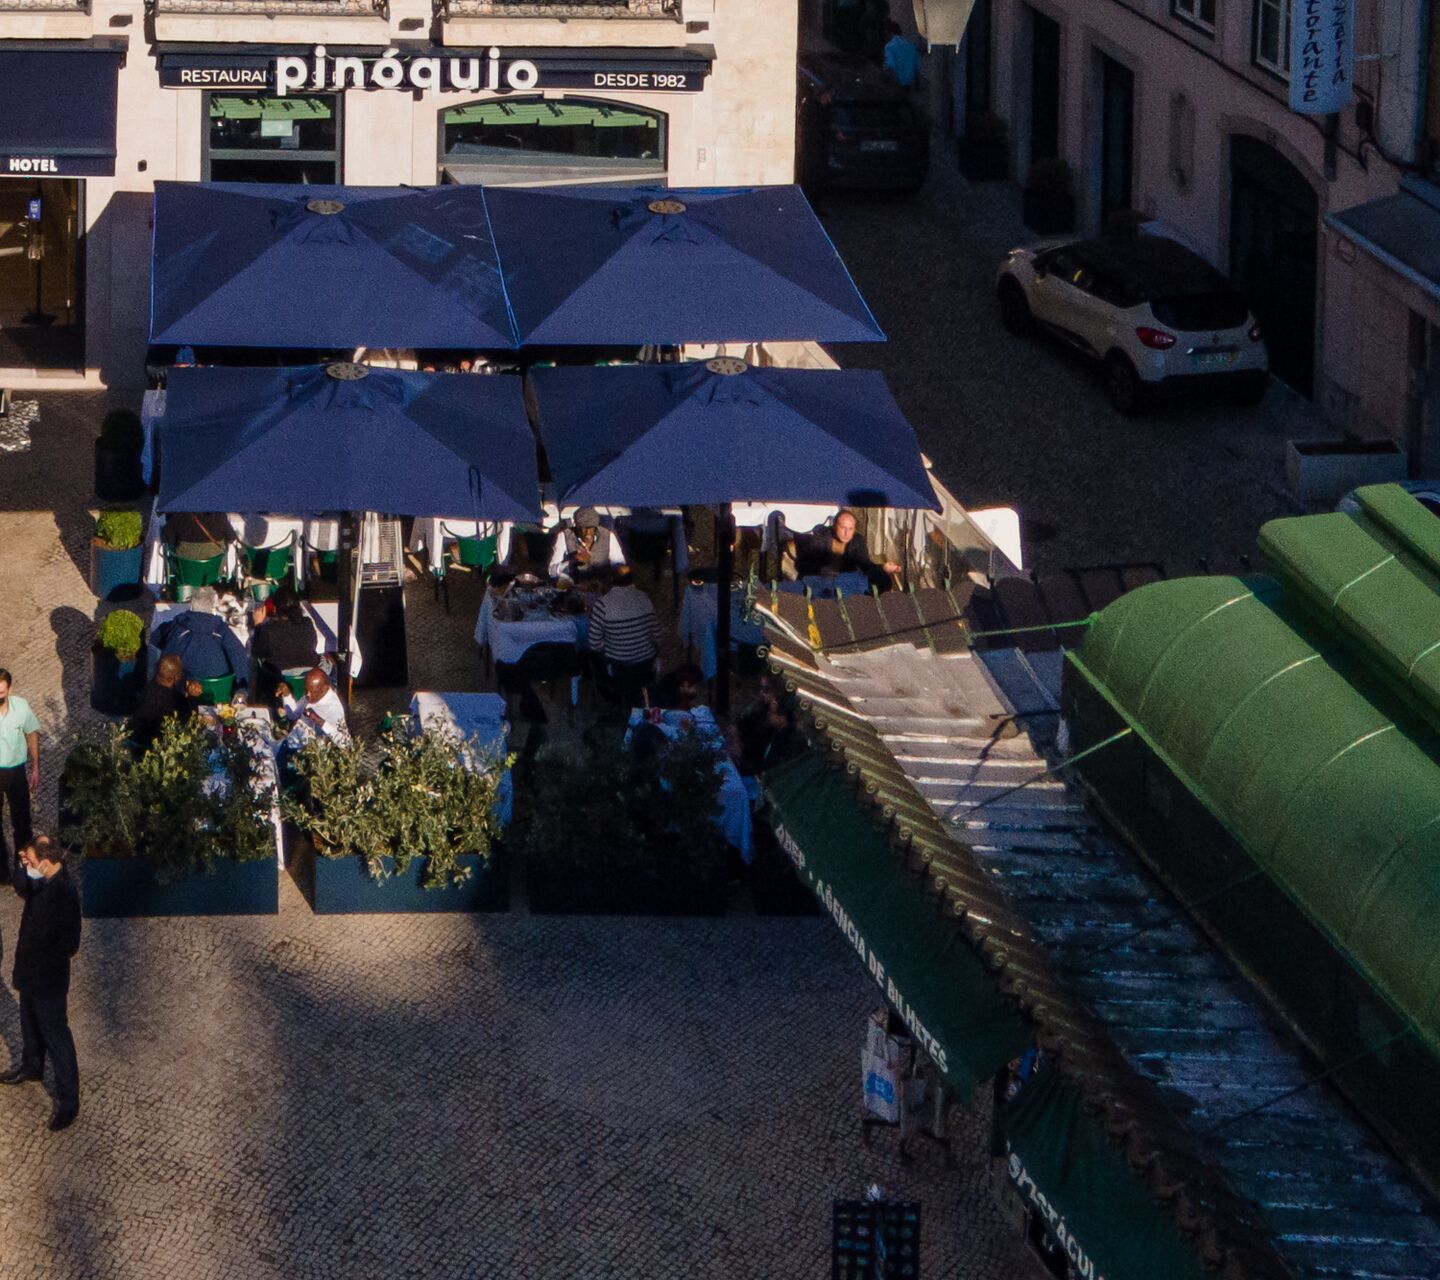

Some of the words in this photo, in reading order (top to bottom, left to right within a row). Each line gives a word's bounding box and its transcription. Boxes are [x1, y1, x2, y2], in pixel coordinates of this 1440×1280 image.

[181, 69, 278, 84] RESTAURAN
[594, 73, 649, 87] DESDE
[652, 74, 687, 88] 1982
[276, 45, 539, 96] pinóquio
[9, 159, 58, 172] HOTEL
[868, 949, 885, 988] DE
[887, 975, 949, 1073] BILHETES
